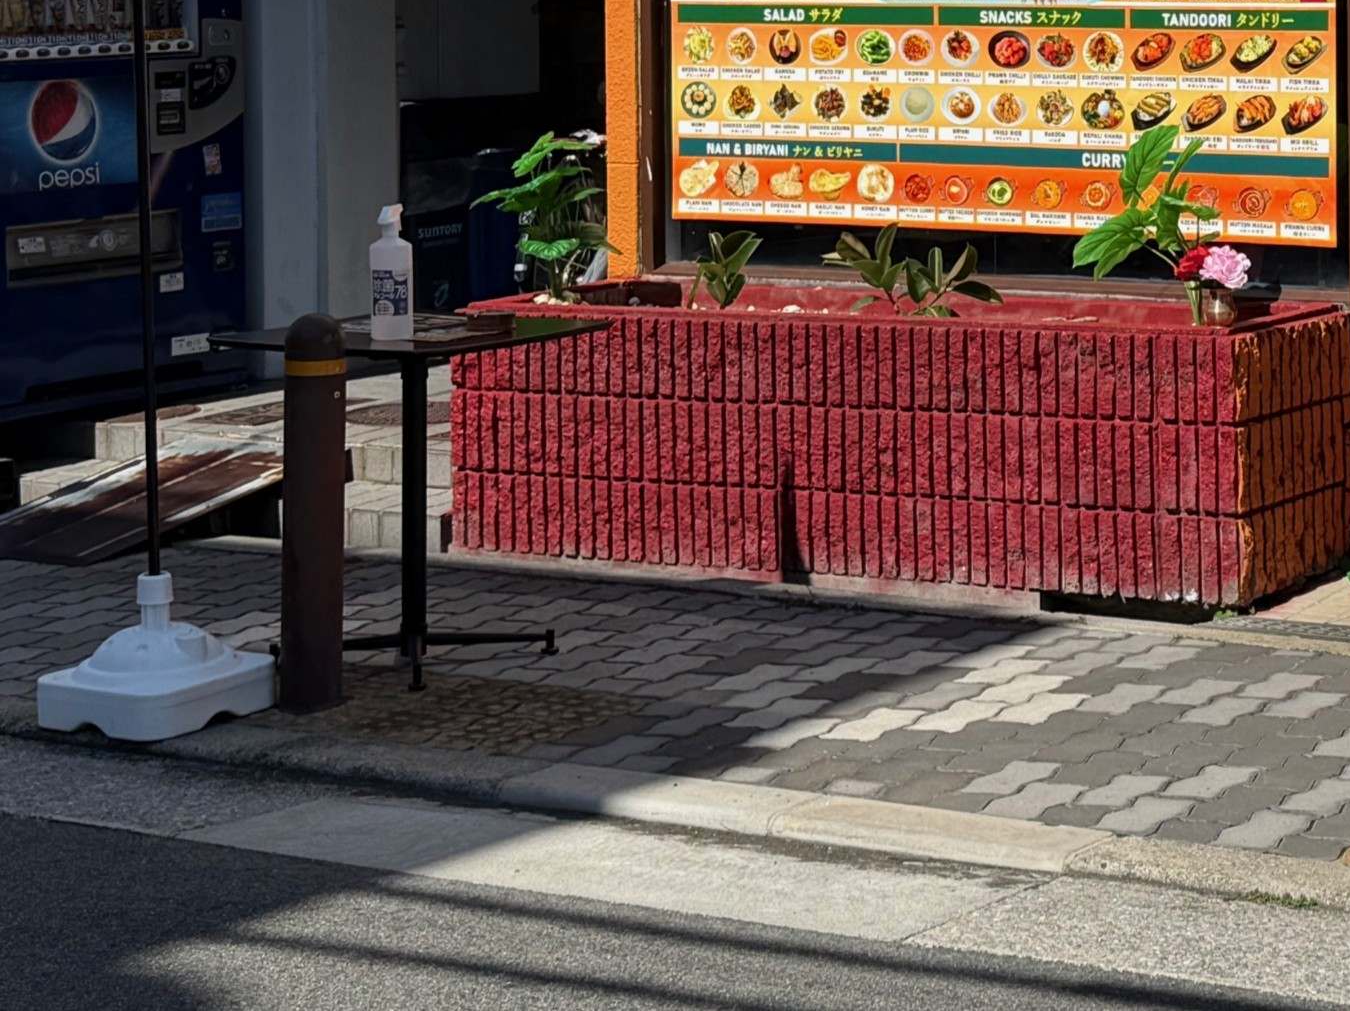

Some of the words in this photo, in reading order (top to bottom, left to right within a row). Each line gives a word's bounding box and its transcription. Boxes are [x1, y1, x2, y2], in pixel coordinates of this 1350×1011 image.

[764, 8, 805, 22] SALAD
[808, 7, 843, 22] サラダ
[980, 9, 1032, 25] SNACKS
[1036, 11, 1082, 26] スナック
[1162, 12, 1232, 28] TANDOORI
[1236, 13, 1295, 29] タンドリー
[707, 143, 731, 156] NAN
[734, 144, 741, 156] &
[745, 143, 789, 157] BIRYANI
[793, 146, 811, 157] ナン
[815, 146, 823, 158] &
[827, 146, 864, 159] ビリヤニ
[39, 162, 101, 191] pepsi
[418, 223, 463, 238] SUNTORY
